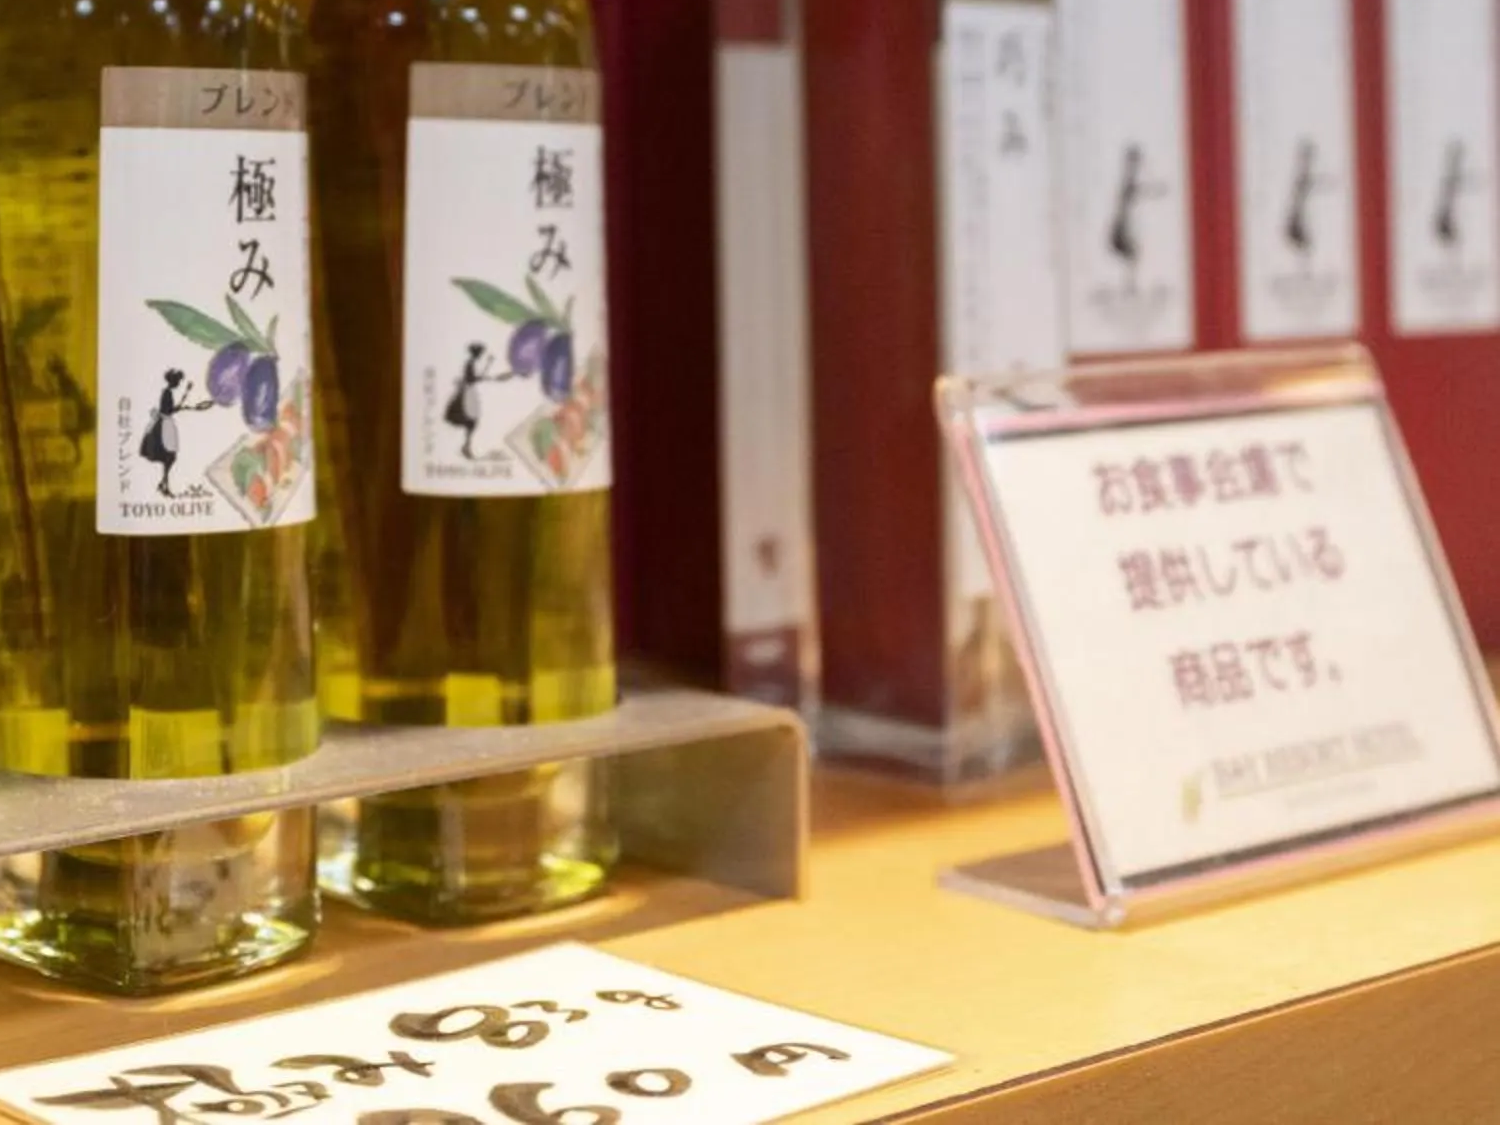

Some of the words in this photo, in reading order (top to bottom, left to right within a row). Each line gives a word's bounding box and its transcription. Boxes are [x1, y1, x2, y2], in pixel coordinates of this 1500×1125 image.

[228, 155, 277, 299] 極み
[530, 144, 574, 277] 極み
[120, 502, 166, 518] TOYO
[170, 501, 213, 517] OLIVE
[1119, 527, 1346, 612] 提供している
[1170, 630, 1344, 708] 商品です。
